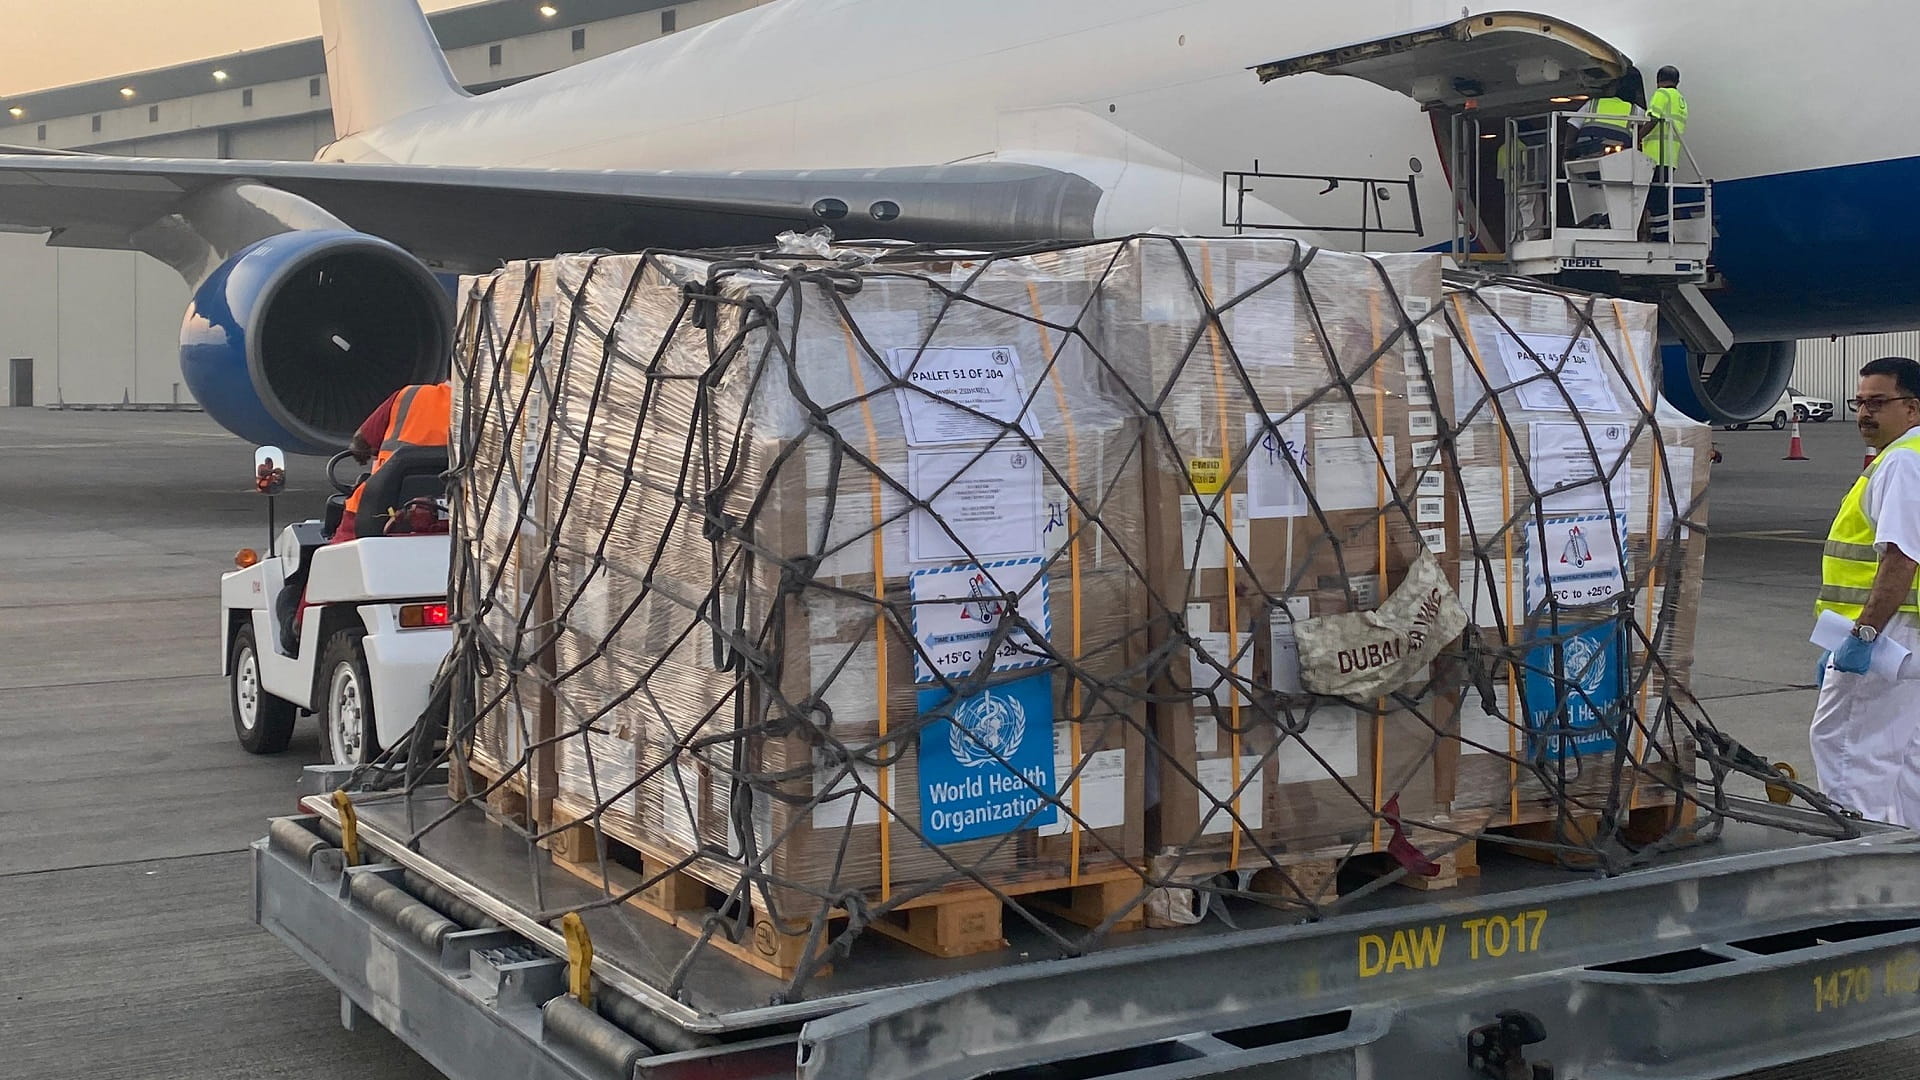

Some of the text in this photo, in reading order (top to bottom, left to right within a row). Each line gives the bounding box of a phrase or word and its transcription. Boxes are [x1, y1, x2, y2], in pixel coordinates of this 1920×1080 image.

[912, 369, 1004, 381] PALLET 51 OF 104
[1573, 590, 1582, 599] to
[1337, 638, 1400, 674] DUBAI
[929, 766, 1046, 804] World Health
[930, 795, 1048, 833] Organization
[1359, 924, 1446, 978] DAW
[1813, 965, 1872, 1013] 1470
